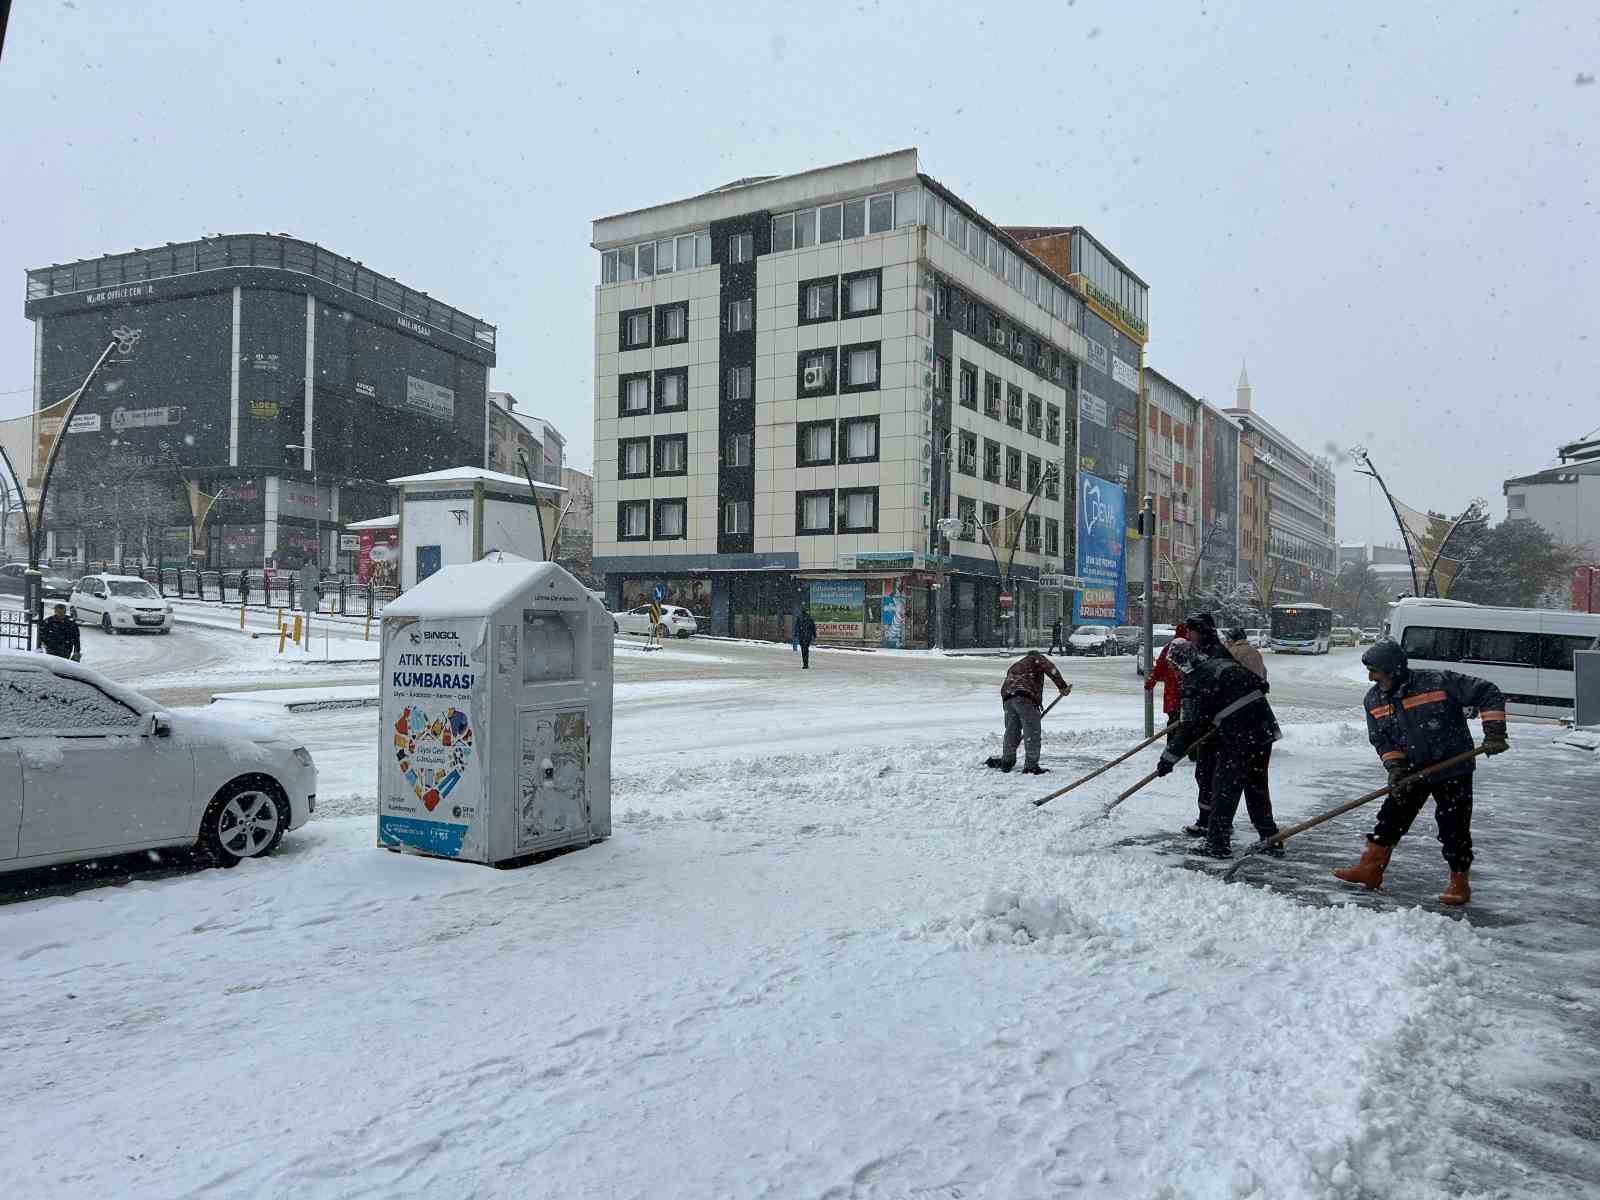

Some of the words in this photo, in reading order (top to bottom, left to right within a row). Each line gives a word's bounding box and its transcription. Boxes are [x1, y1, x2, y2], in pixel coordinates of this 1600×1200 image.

[1039, 577, 1058, 586] OTEL
[398, 653, 423, 666] ATIK
[424, 651, 470, 667] TEKSTİL
